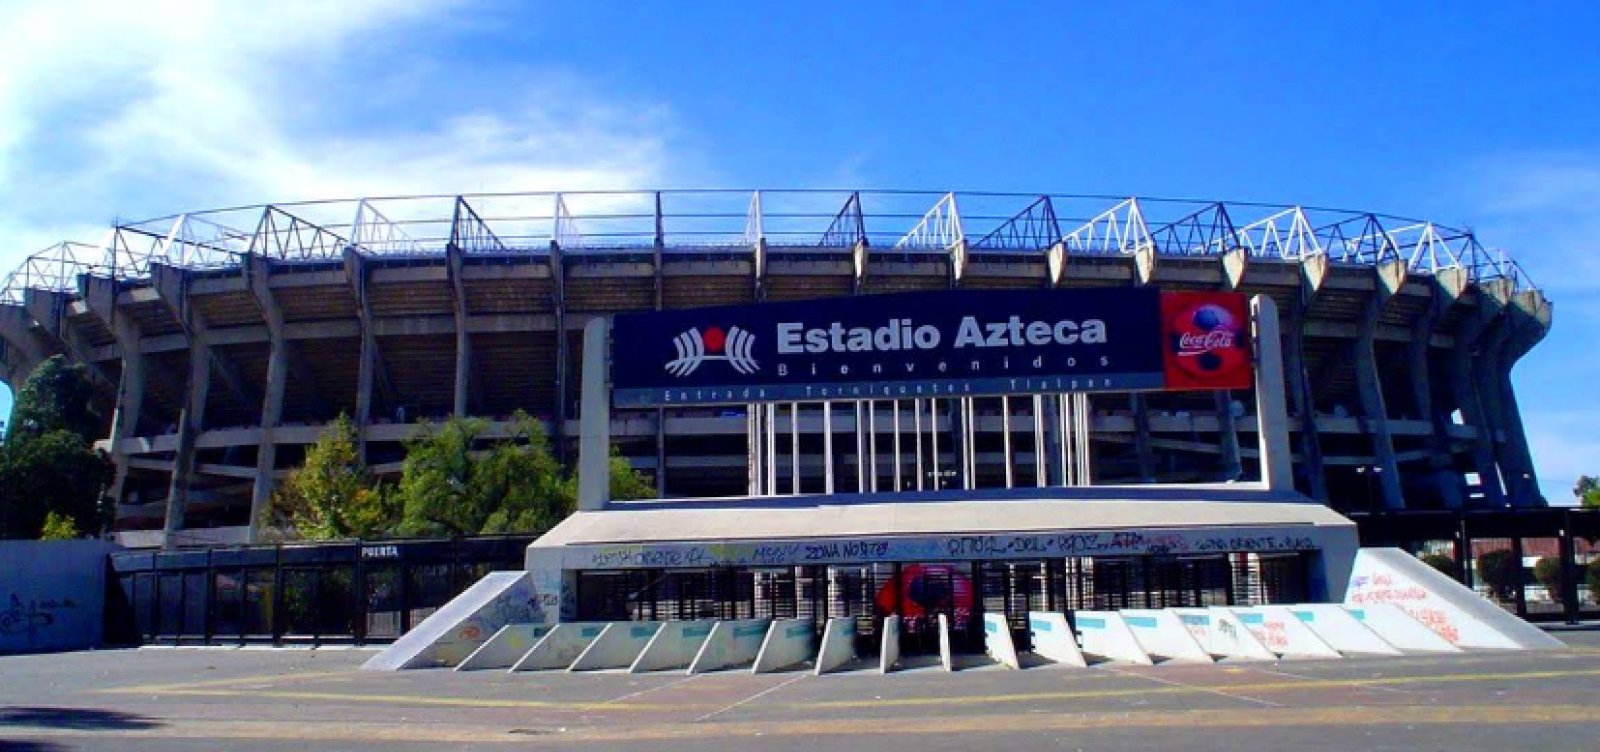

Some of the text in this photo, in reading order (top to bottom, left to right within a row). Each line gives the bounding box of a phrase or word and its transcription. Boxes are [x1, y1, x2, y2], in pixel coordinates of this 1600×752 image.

[777, 316, 1107, 354] Estadio Azteca
[1009, 377, 1112, 391] Tlalpan
[361, 546, 400, 558] PUERTA
[804, 542, 841, 560] ZONA
